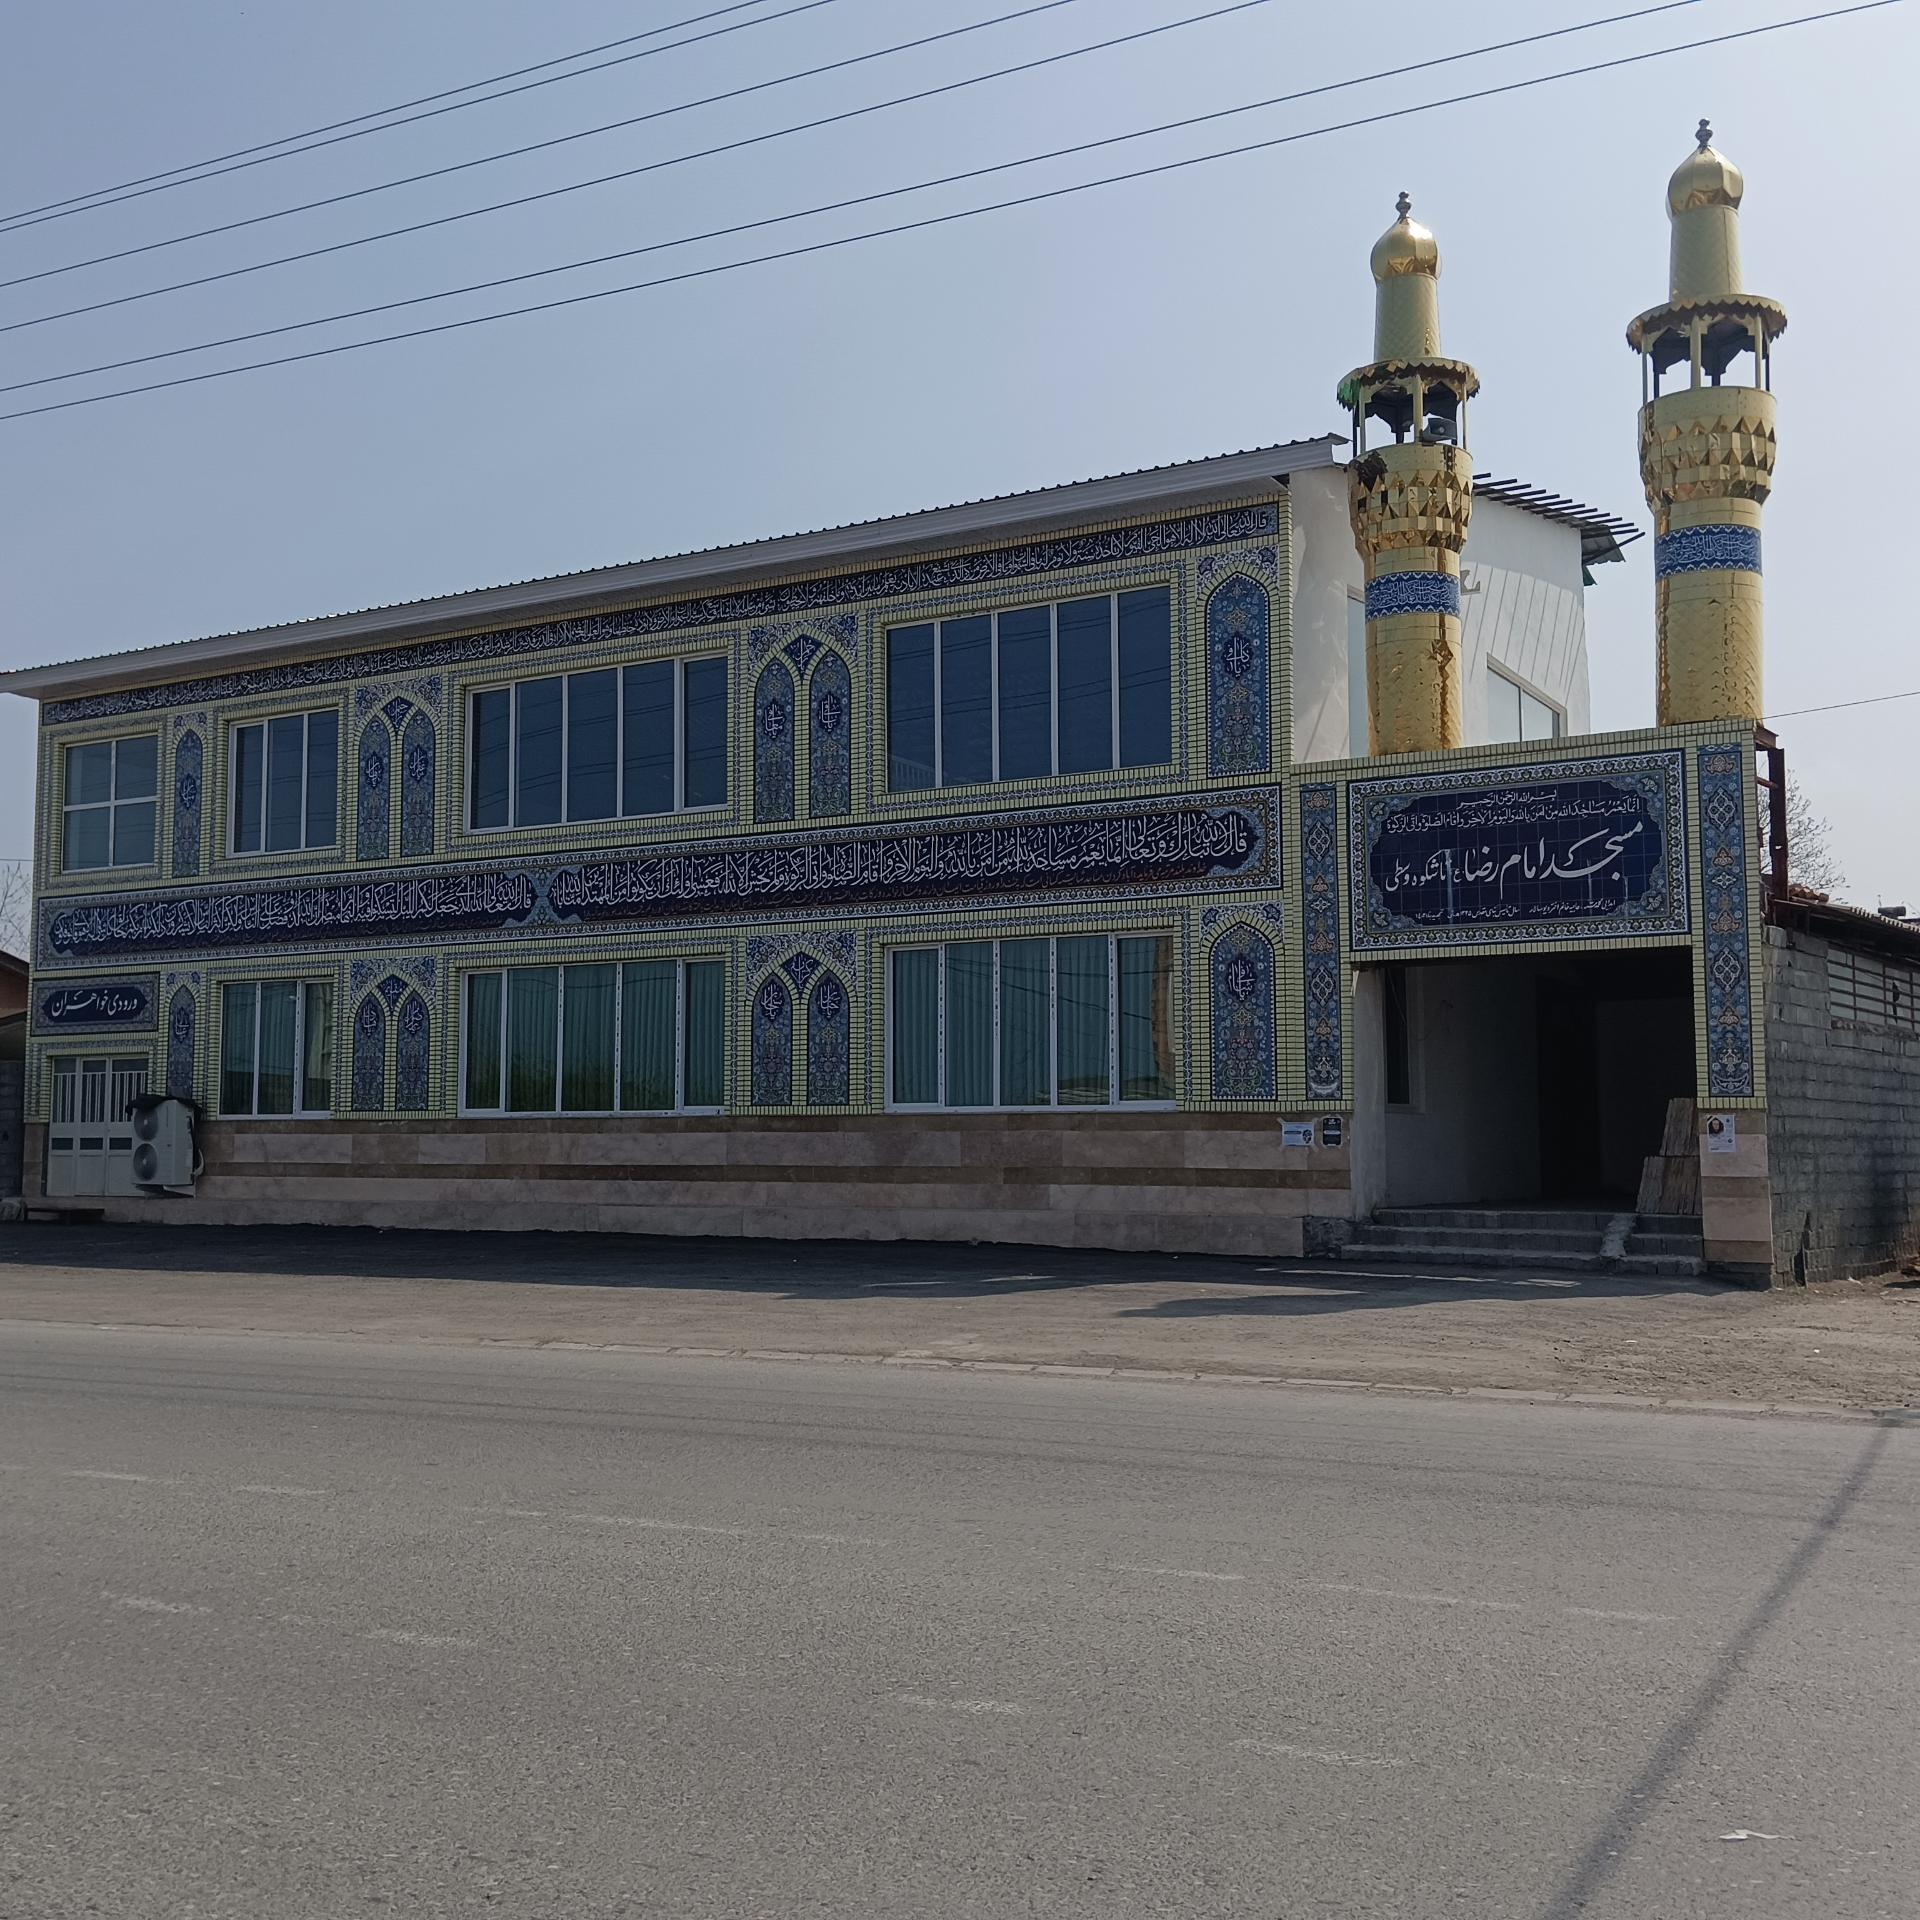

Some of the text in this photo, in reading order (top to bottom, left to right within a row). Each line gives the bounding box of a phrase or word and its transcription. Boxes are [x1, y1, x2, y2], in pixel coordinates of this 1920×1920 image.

[1465, 845, 1499, 882] رضا
[1500, 837, 1545, 900] امام
[1539, 821, 1643, 881] مسجد
[51, 989, 138, 1017] ورودی خواهران
